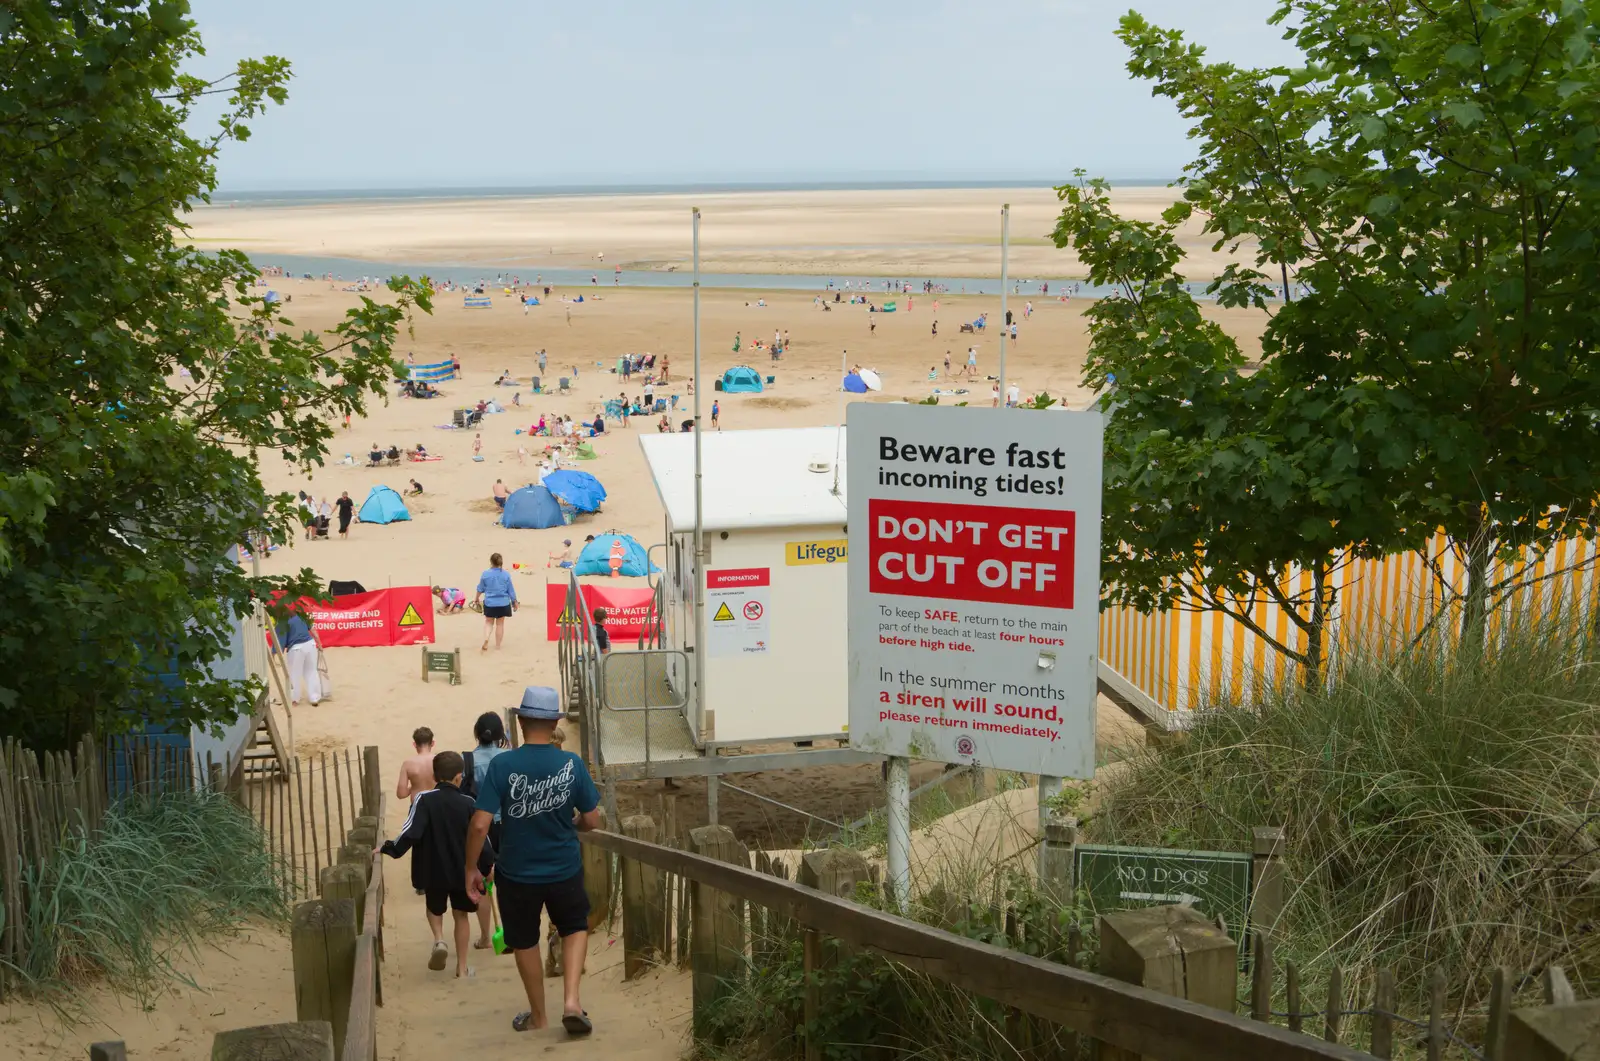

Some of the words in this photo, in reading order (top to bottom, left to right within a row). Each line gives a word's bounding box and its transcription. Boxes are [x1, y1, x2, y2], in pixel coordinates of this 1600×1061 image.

[879, 436, 996, 466] Beware
[1006, 442, 1066, 470] fast
[879, 467, 988, 497] incoming
[995, 473, 1064, 496] tides!
[878, 515, 989, 546] DON'T
[998, 524, 1068, 551] GET
[797, 543, 848, 563] Lifegu
[717, 574, 760, 582] INFORMATION
[877, 551, 965, 585] CUT
[977, 559, 1057, 592] OFF
[330, 611, 360, 620] WATER
[361, 609, 381, 618] AND
[600, 606, 621, 615] EEP
[605, 617, 628, 626] RONG
[879, 605, 892, 617] To
[896, 607, 921, 620] keep
[924, 609, 961, 624] SAFE,
[964, 613, 999, 627] return
[1002, 616, 1015, 628] to
[1018, 616, 1037, 630] the
[1040, 620, 1068, 632] main
[312, 622, 336, 630] RONG
[337, 619, 384, 630] CURRENTS
[879, 622, 898, 633] part
[900, 622, 911, 633] of
[914, 624, 929, 634] the
[931, 625, 959, 637] beach
[961, 628, 972, 638] at
[974, 629, 996, 640] least
[999, 631, 1025, 643] four
[1029, 633, 1065, 646] hours
[879, 635, 917, 647] before
[920, 637, 945, 652] high
[948, 640, 975, 653] tide.
[879, 667, 893, 683] In
[898, 669, 925, 686] the
[930, 676, 996, 693] summer
[1002, 682, 1065, 700] months
[879, 691, 890, 703] a
[896, 691, 945, 709] siren
[952, 696, 987, 713] will
[994, 702, 1064, 725] sound,
[879, 709, 921, 724] please
[924, 714, 968, 729] return
[972, 719, 1061, 742] immediately.
[508, 758, 575, 801] Original
[508, 788, 571, 819] Studios
[1116, 865, 1146, 882] NO
[1153, 867, 1209, 885] DOGS
